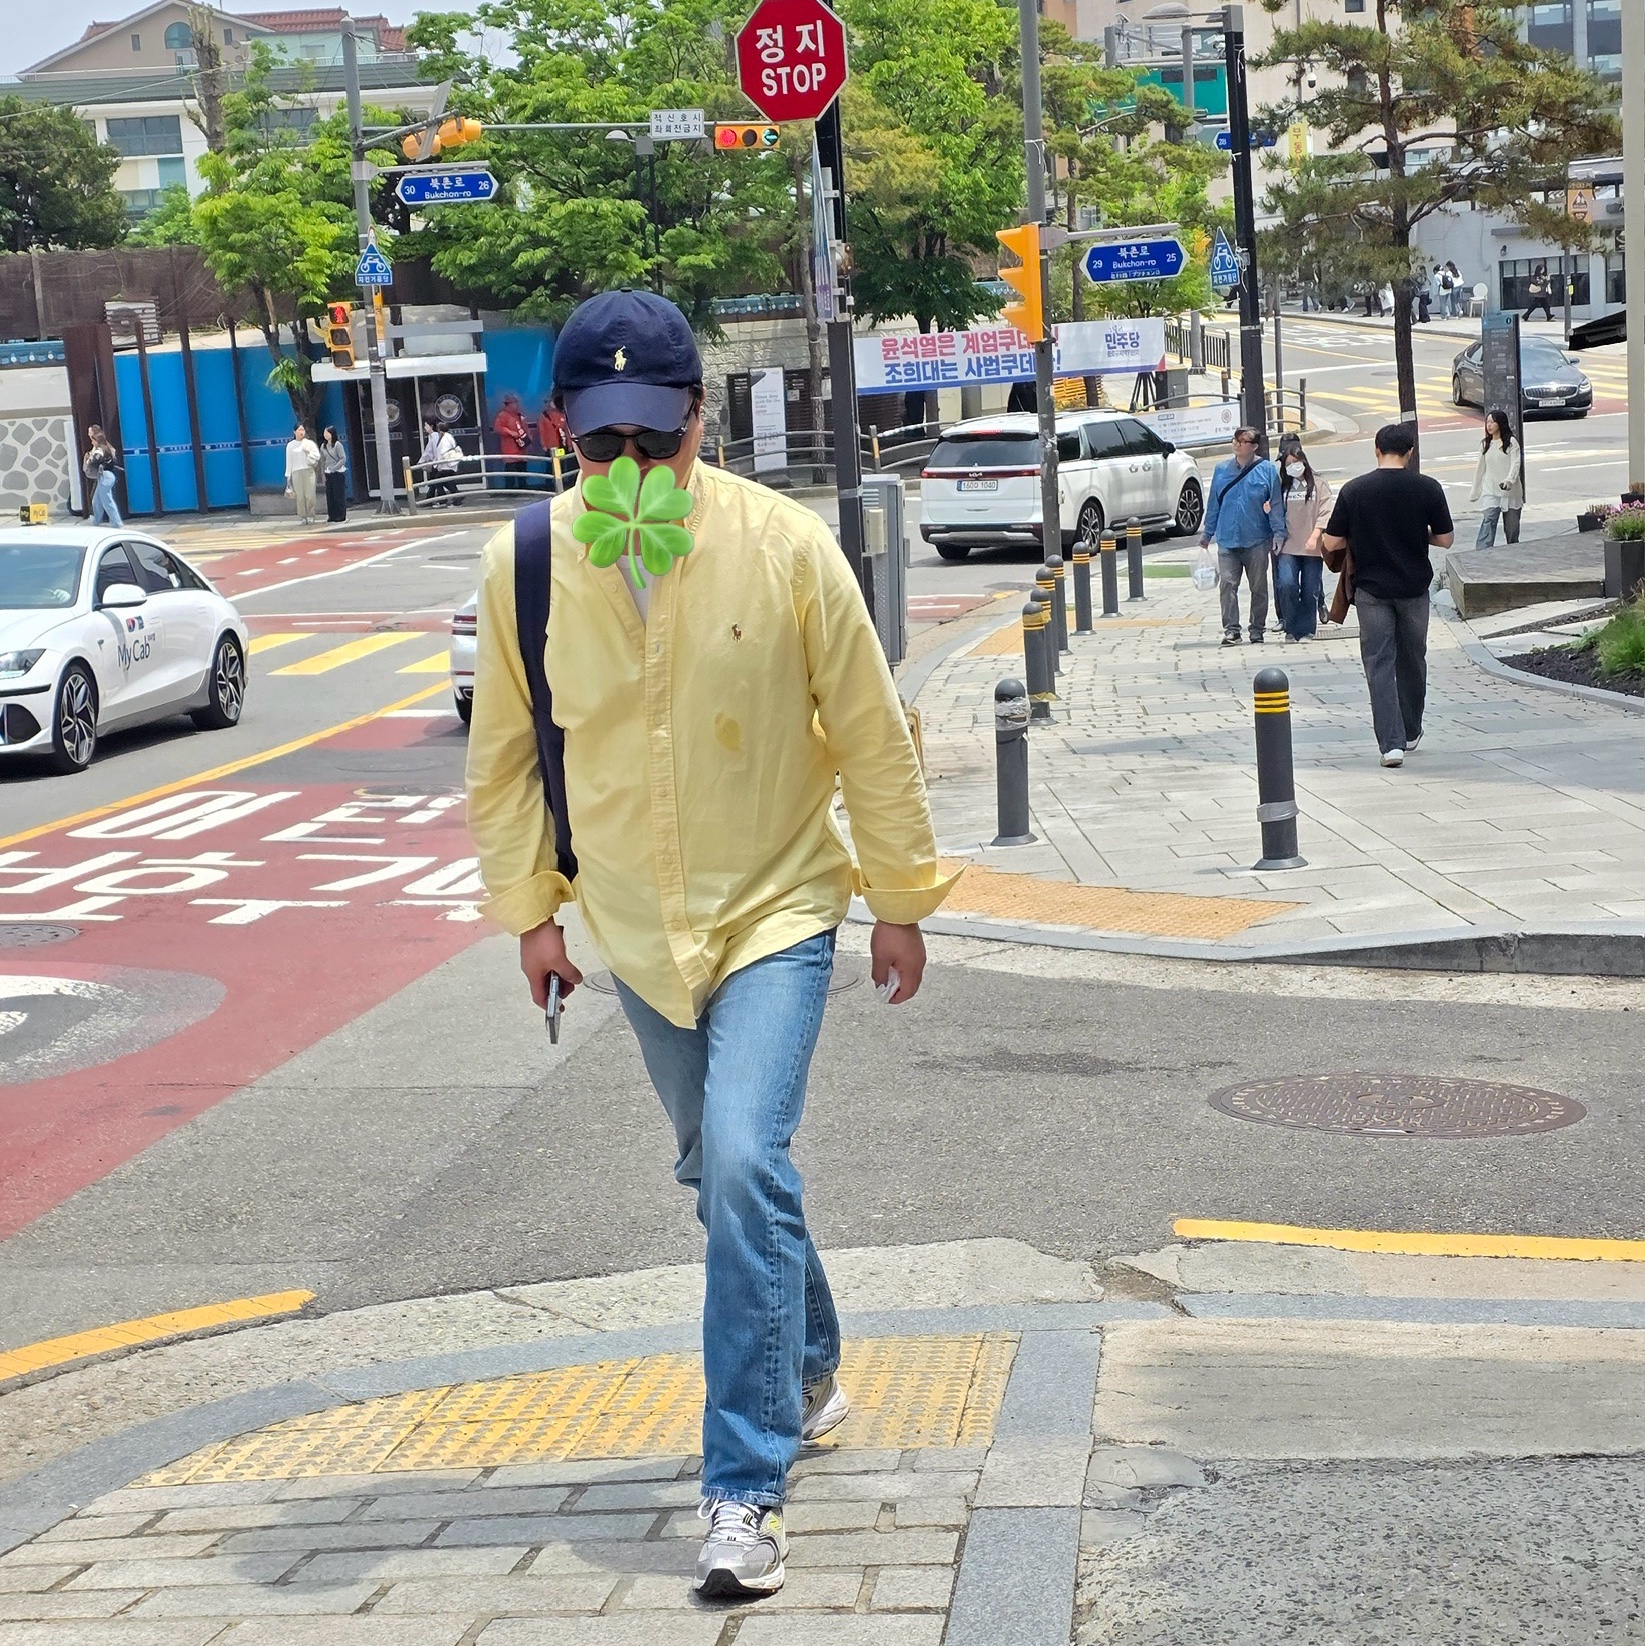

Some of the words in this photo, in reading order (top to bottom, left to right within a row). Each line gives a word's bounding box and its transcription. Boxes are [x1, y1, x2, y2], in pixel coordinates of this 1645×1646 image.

[755, 19, 826, 64] 정지
[761, 62, 827, 97] STOP
[654, 123, 701, 133] 좌회전금지
[404, 185, 416, 195] 30
[429, 176, 465, 190] 북촌로
[478, 180, 490, 190] 26
[424, 190, 472, 199] Bukchon-ro
[1092, 260, 1103, 269] 29
[1117, 245, 1151, 259] 북촌로
[1166, 253, 1177, 262] 25
[1112, 259, 1157, 269] Bukchon-ro
[881, 332, 956, 361] 윤석열은
[960, 326, 1059, 355] 계엄쿠데!
[1104, 331, 1140, 350] 민주당
[884, 358, 958, 385] 조희대는
[964, 349, 1061, 378] 사법쿠데!
[981, 481, 996, 489] 1040
